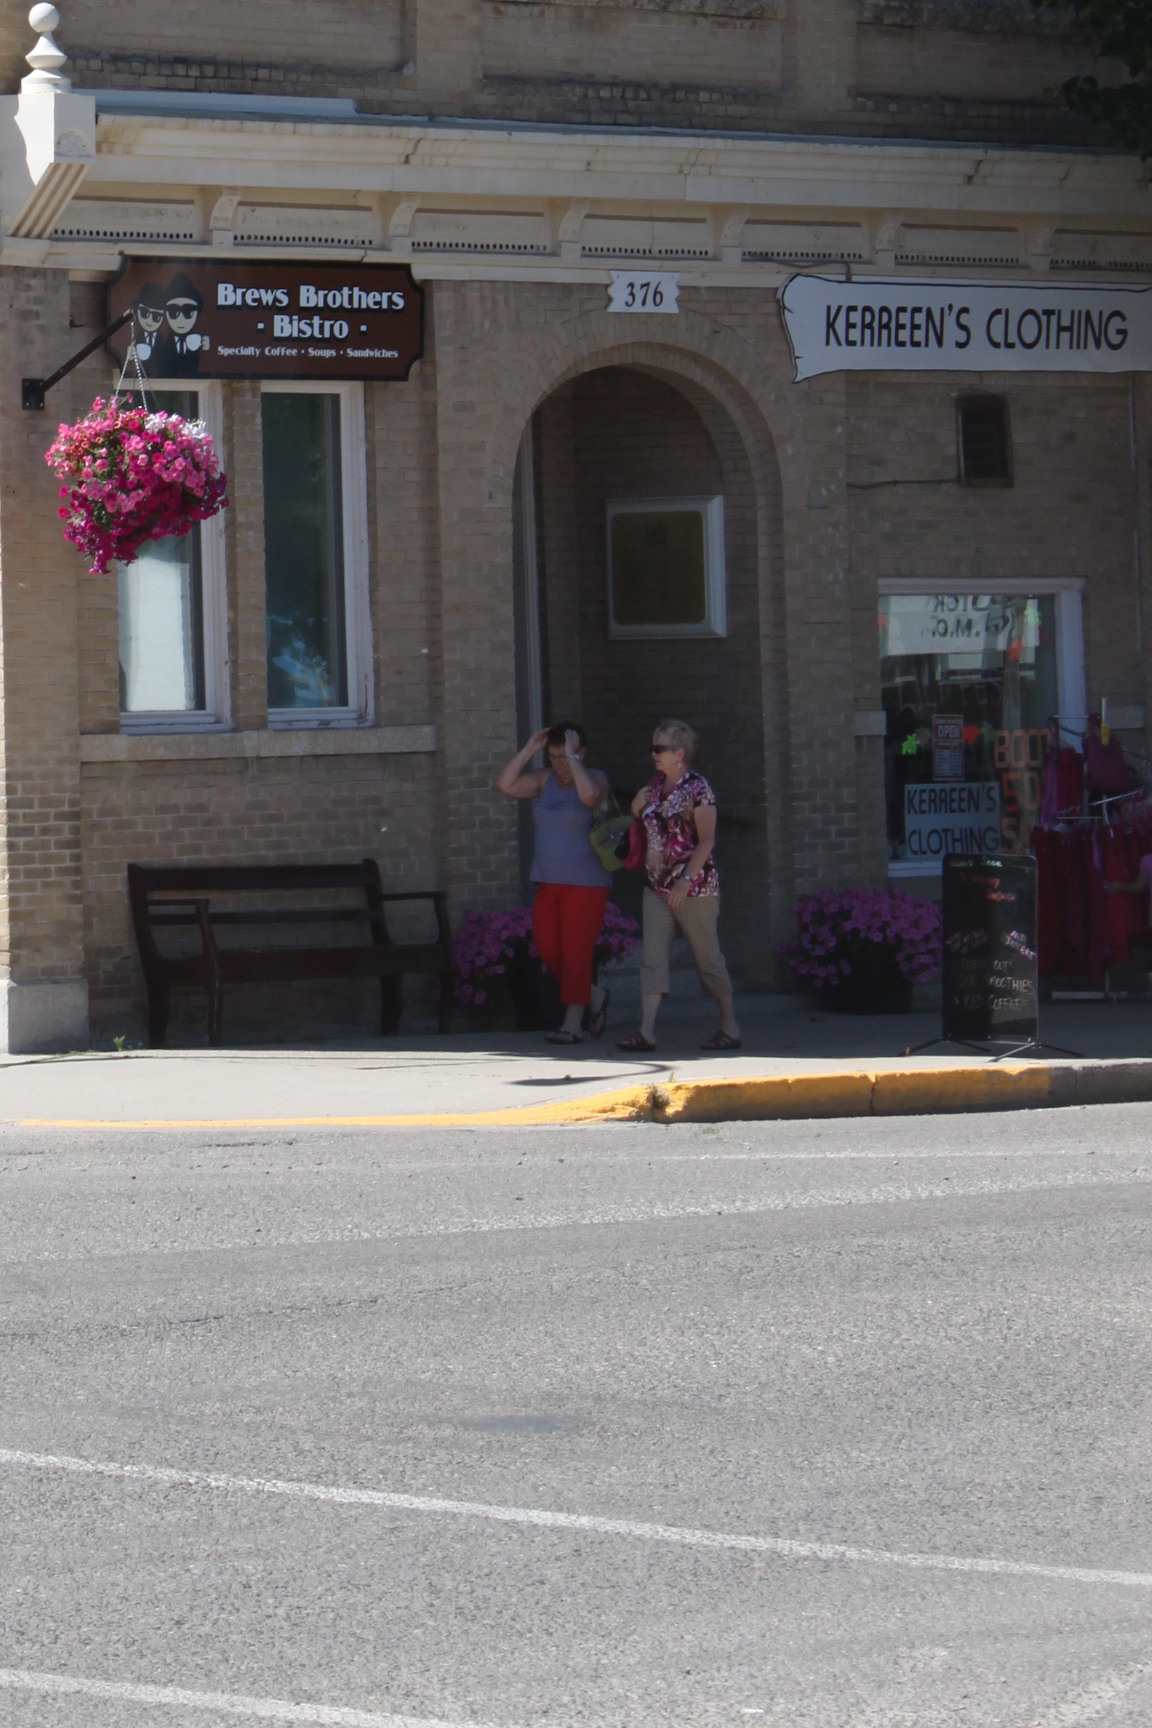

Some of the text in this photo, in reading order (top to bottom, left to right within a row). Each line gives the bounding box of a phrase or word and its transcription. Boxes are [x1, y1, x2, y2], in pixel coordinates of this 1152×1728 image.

[217, 283, 405, 311] Brews Brothers
[624, 281, 665, 308] 376
[273, 314, 349, 339] Bistro
[824, 303, 1129, 352] KERREEN'S CLOTHING
[217, 345, 399, 359] Specialty Coffee Soups Sandwiches
[937, 724, 960, 739] OPEN
[907, 786, 997, 815] KERREEN'S
[908, 827, 998, 855] CLOTHING
